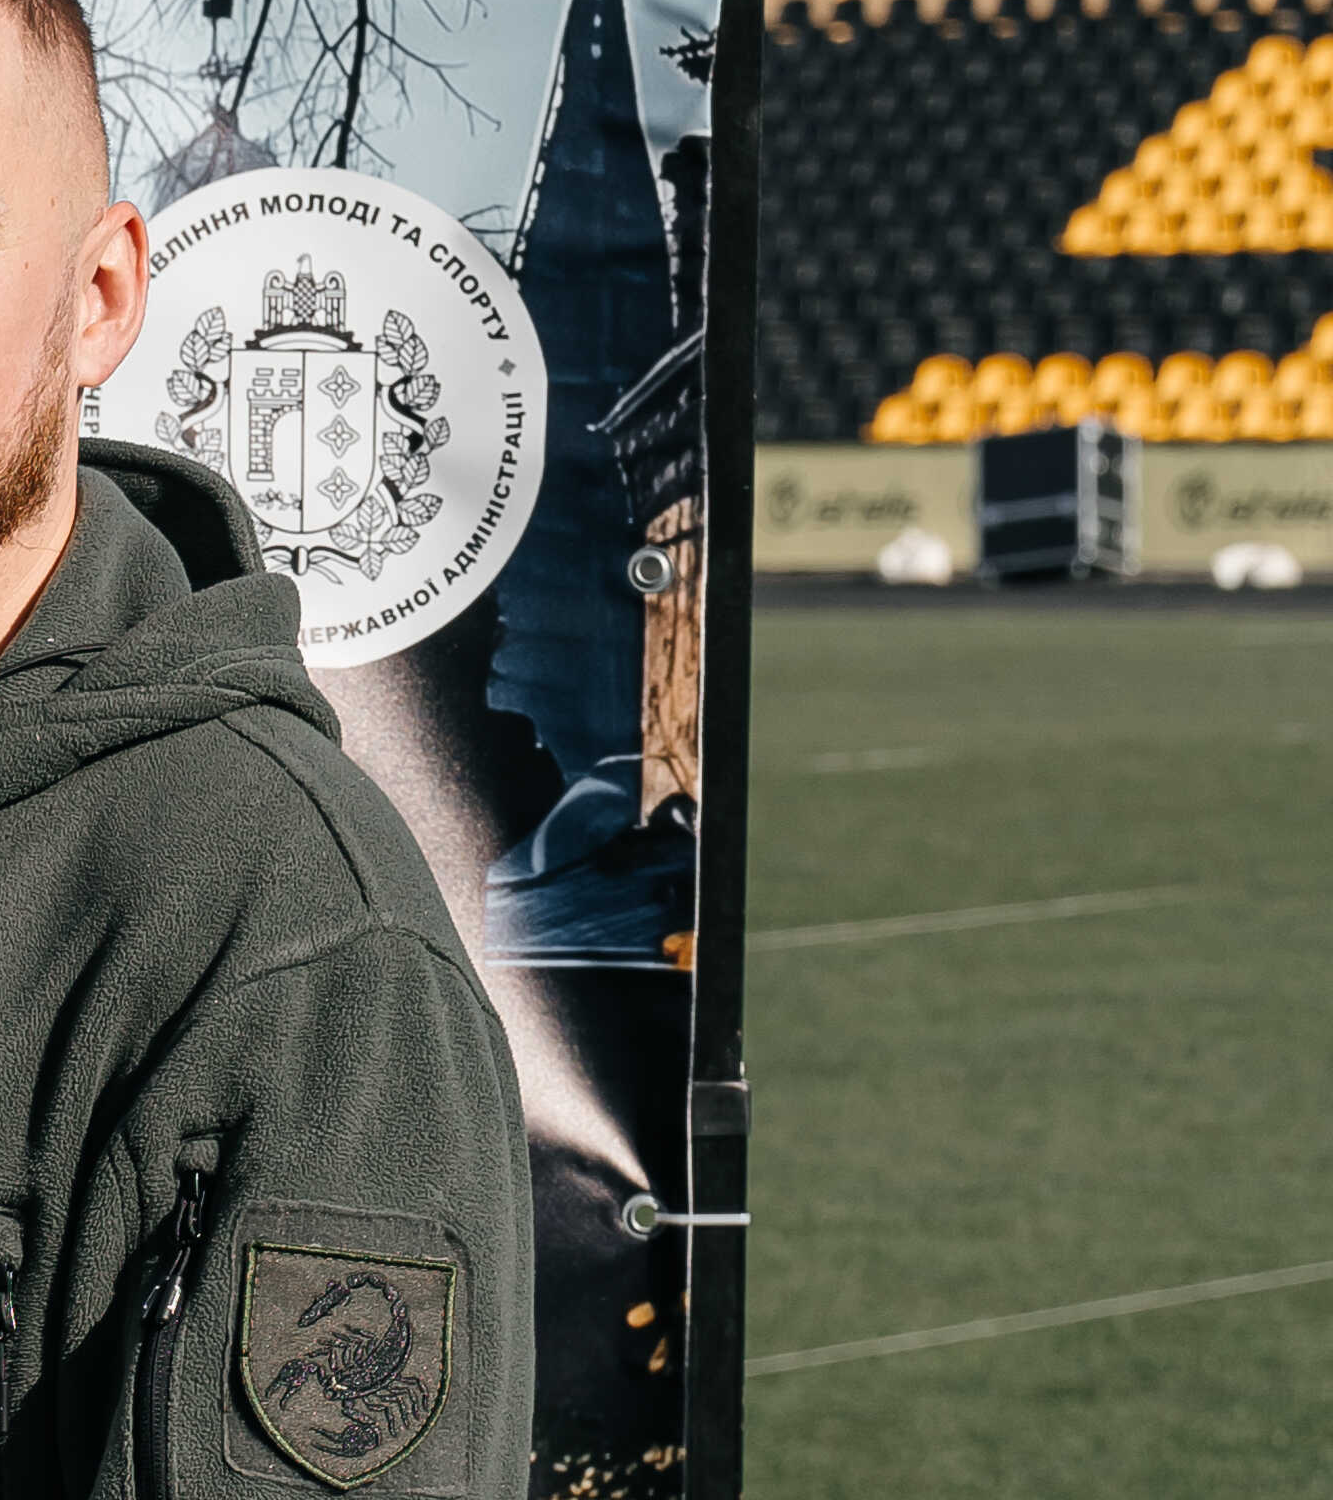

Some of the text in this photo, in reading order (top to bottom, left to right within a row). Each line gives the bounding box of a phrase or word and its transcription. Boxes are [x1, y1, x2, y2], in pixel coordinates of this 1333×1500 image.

[149, 193, 510, 344] ВЛІННЯ МОЛОДІ ТА СПОРТУ
[442, 391, 526, 586] АДМІНІСТРАЦІЇ
